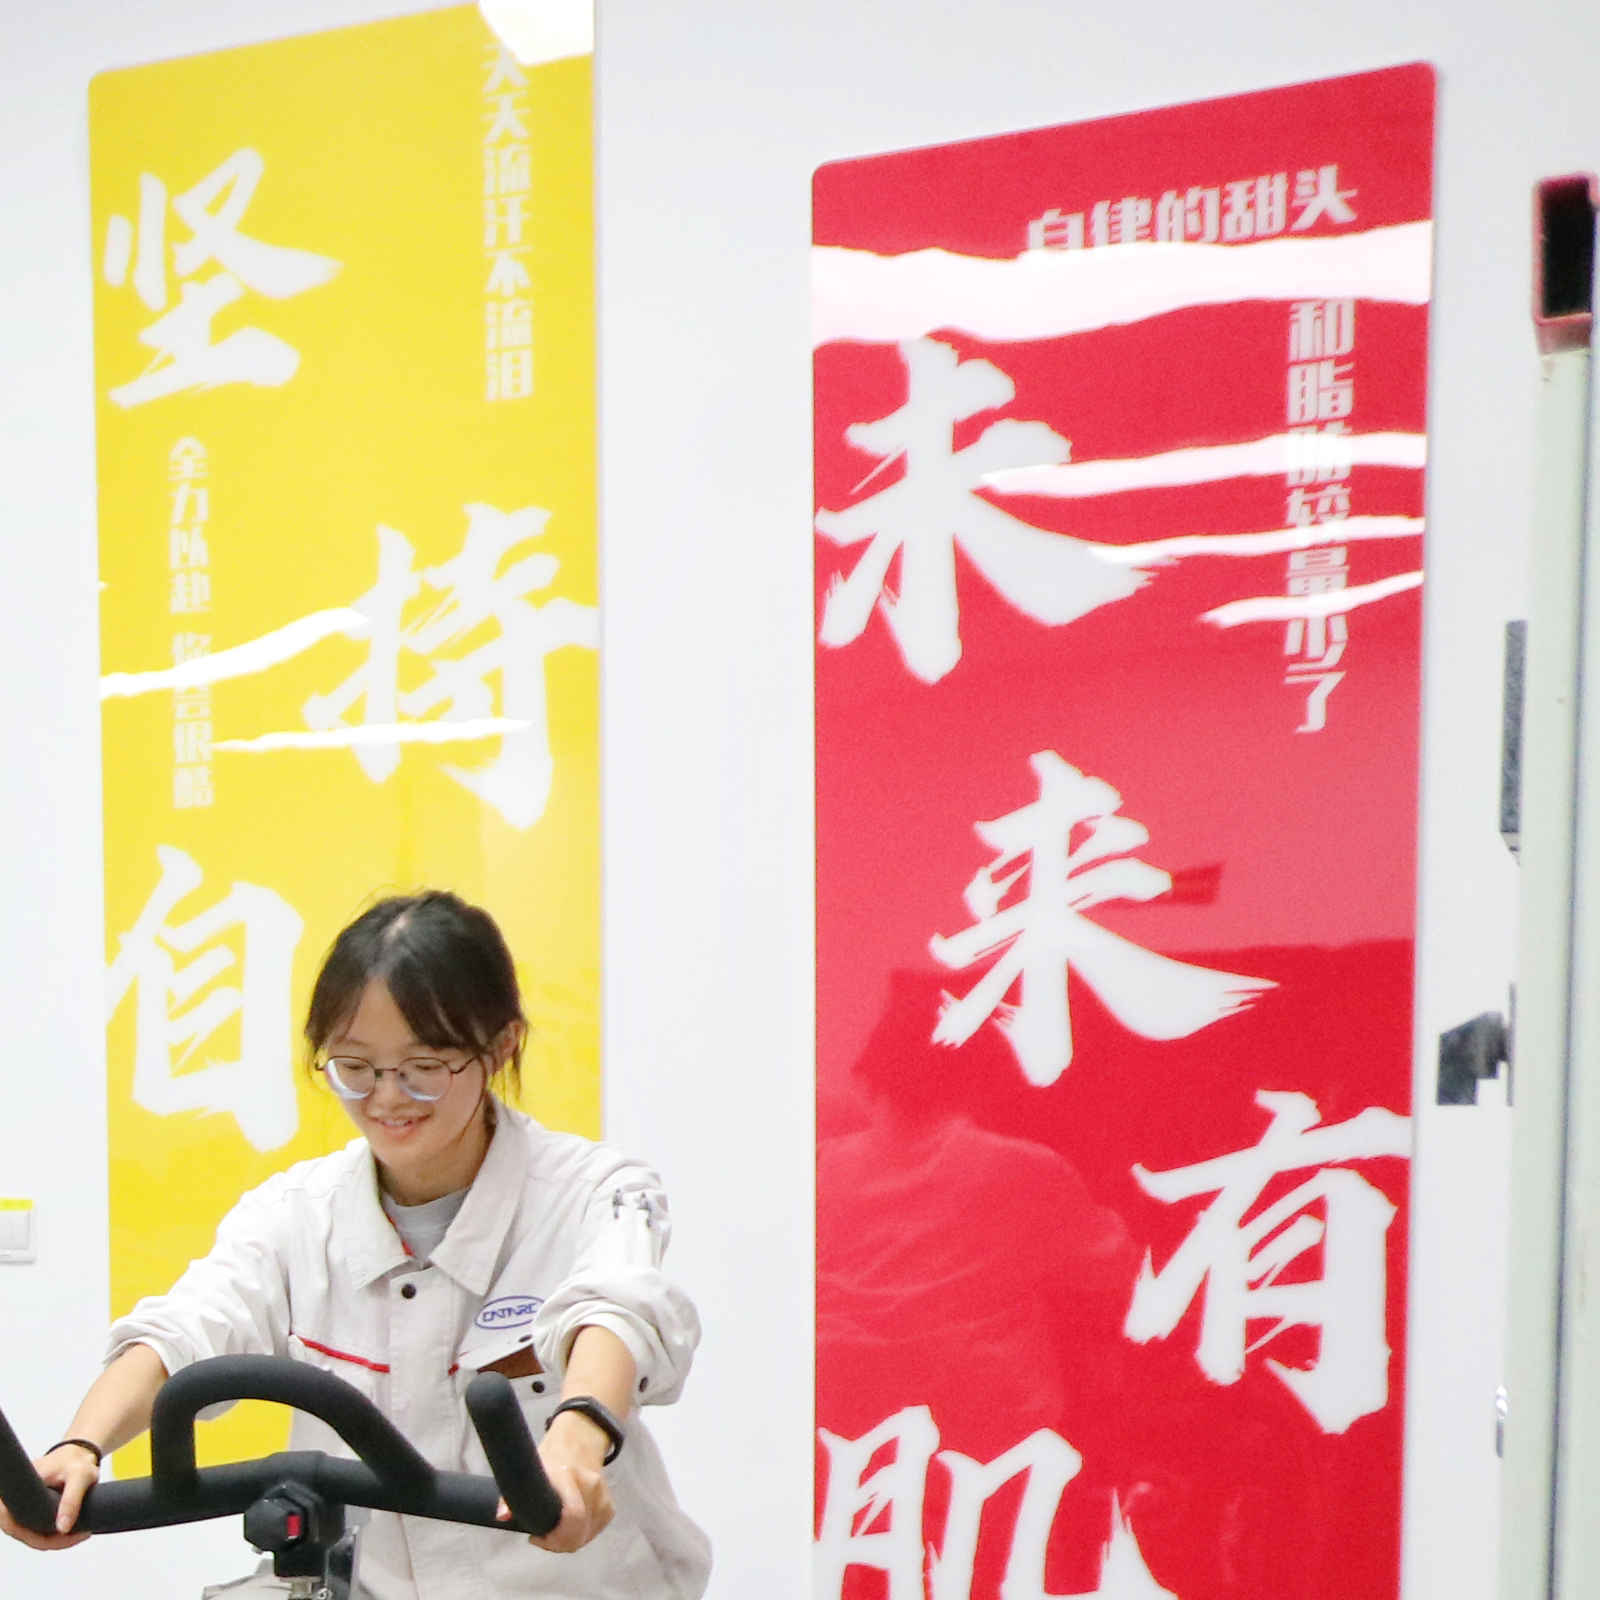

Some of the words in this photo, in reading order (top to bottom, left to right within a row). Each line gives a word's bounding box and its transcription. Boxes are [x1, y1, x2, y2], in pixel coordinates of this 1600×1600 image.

[1026, 164, 1359, 251] 自律的甜头
[168, 435, 212, 616] 全力以赴
